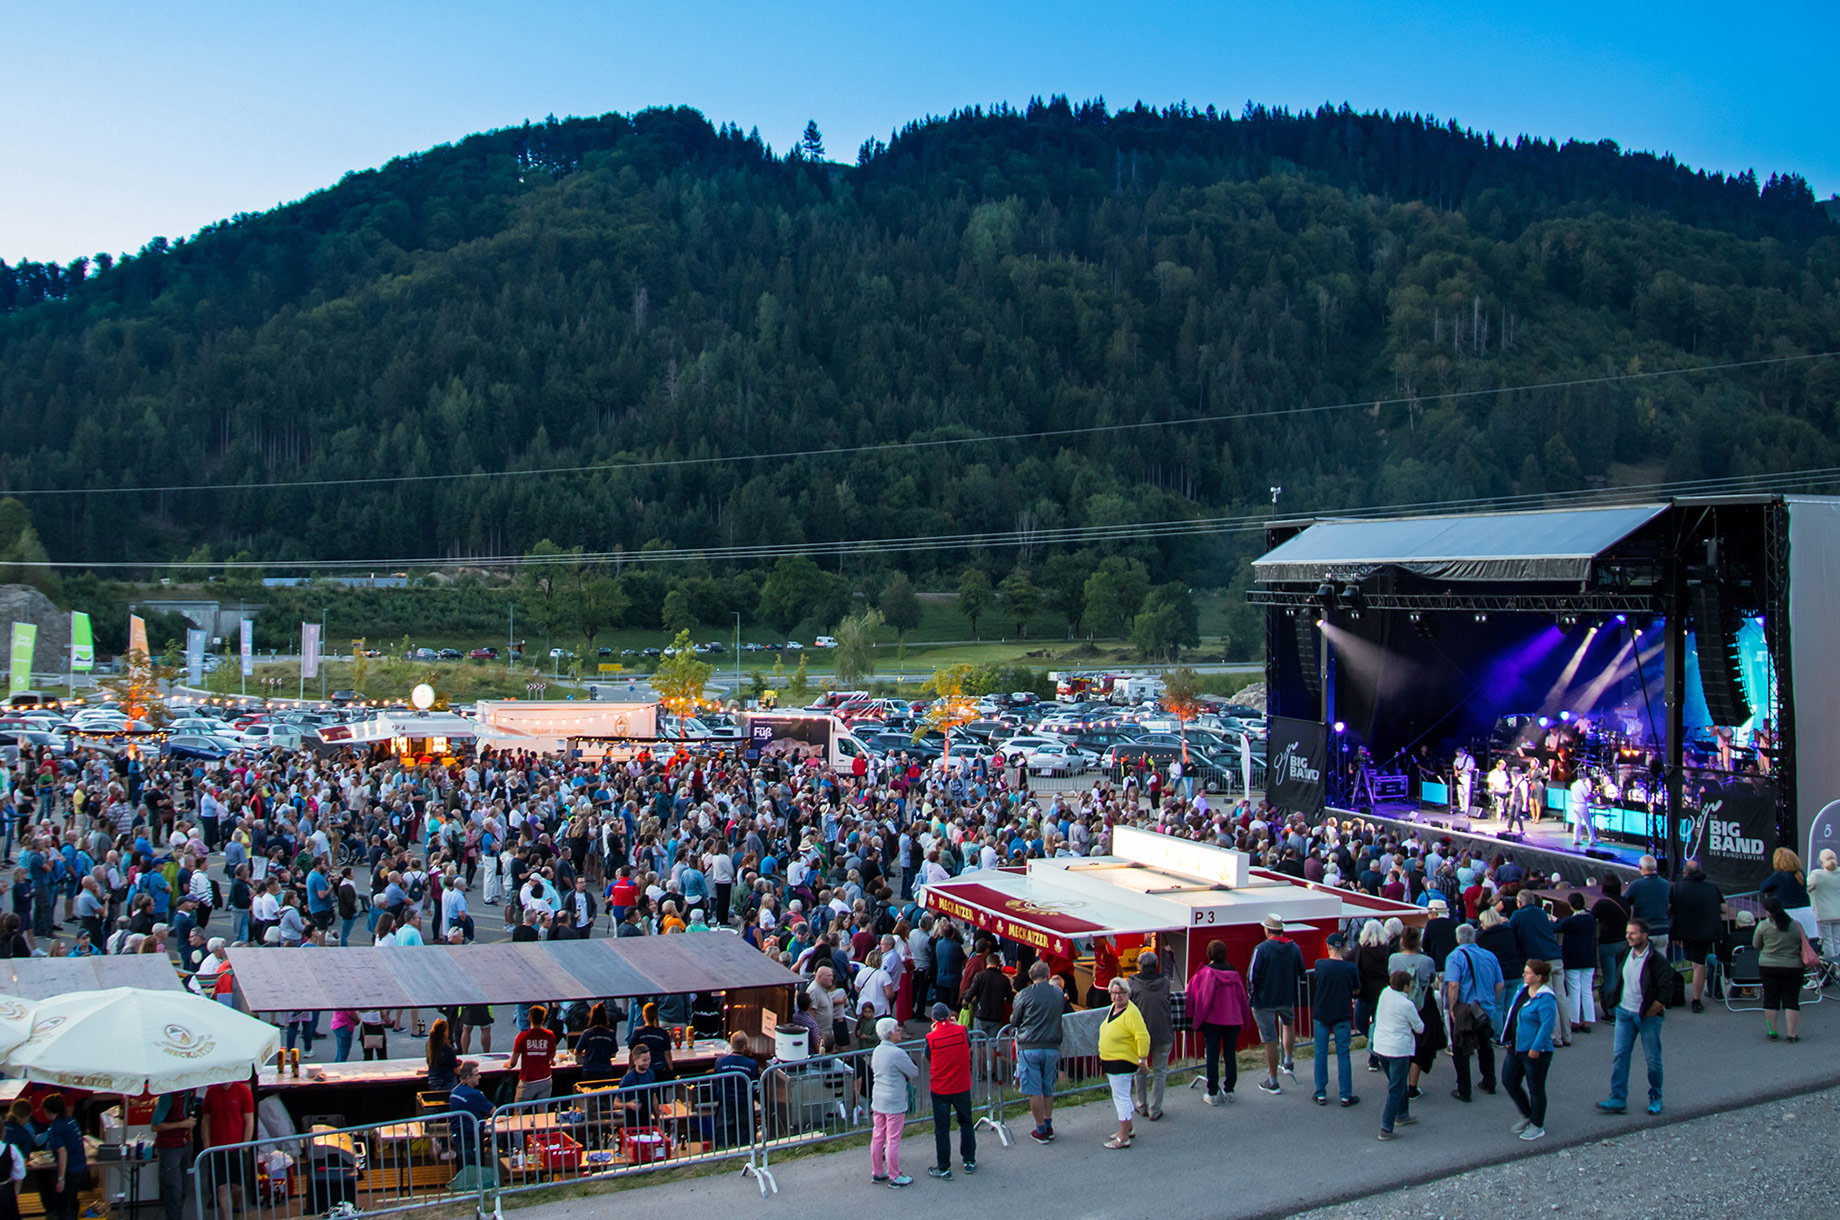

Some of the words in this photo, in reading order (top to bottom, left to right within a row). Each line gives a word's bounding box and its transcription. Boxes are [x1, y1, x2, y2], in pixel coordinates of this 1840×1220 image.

[754, 726, 773, 740] Füß
[1290, 755, 1308, 769] BIG
[1709, 820, 1741, 837] BIG
[1709, 834, 1765, 855] BAND
[938, 897, 975, 922] MECKATZER
[1194, 911, 1204, 925] P
[1207, 910, 1215, 924] 3
[1008, 923, 1049, 949] MECKATZER
[526, 1039, 549, 1050] BAUER
